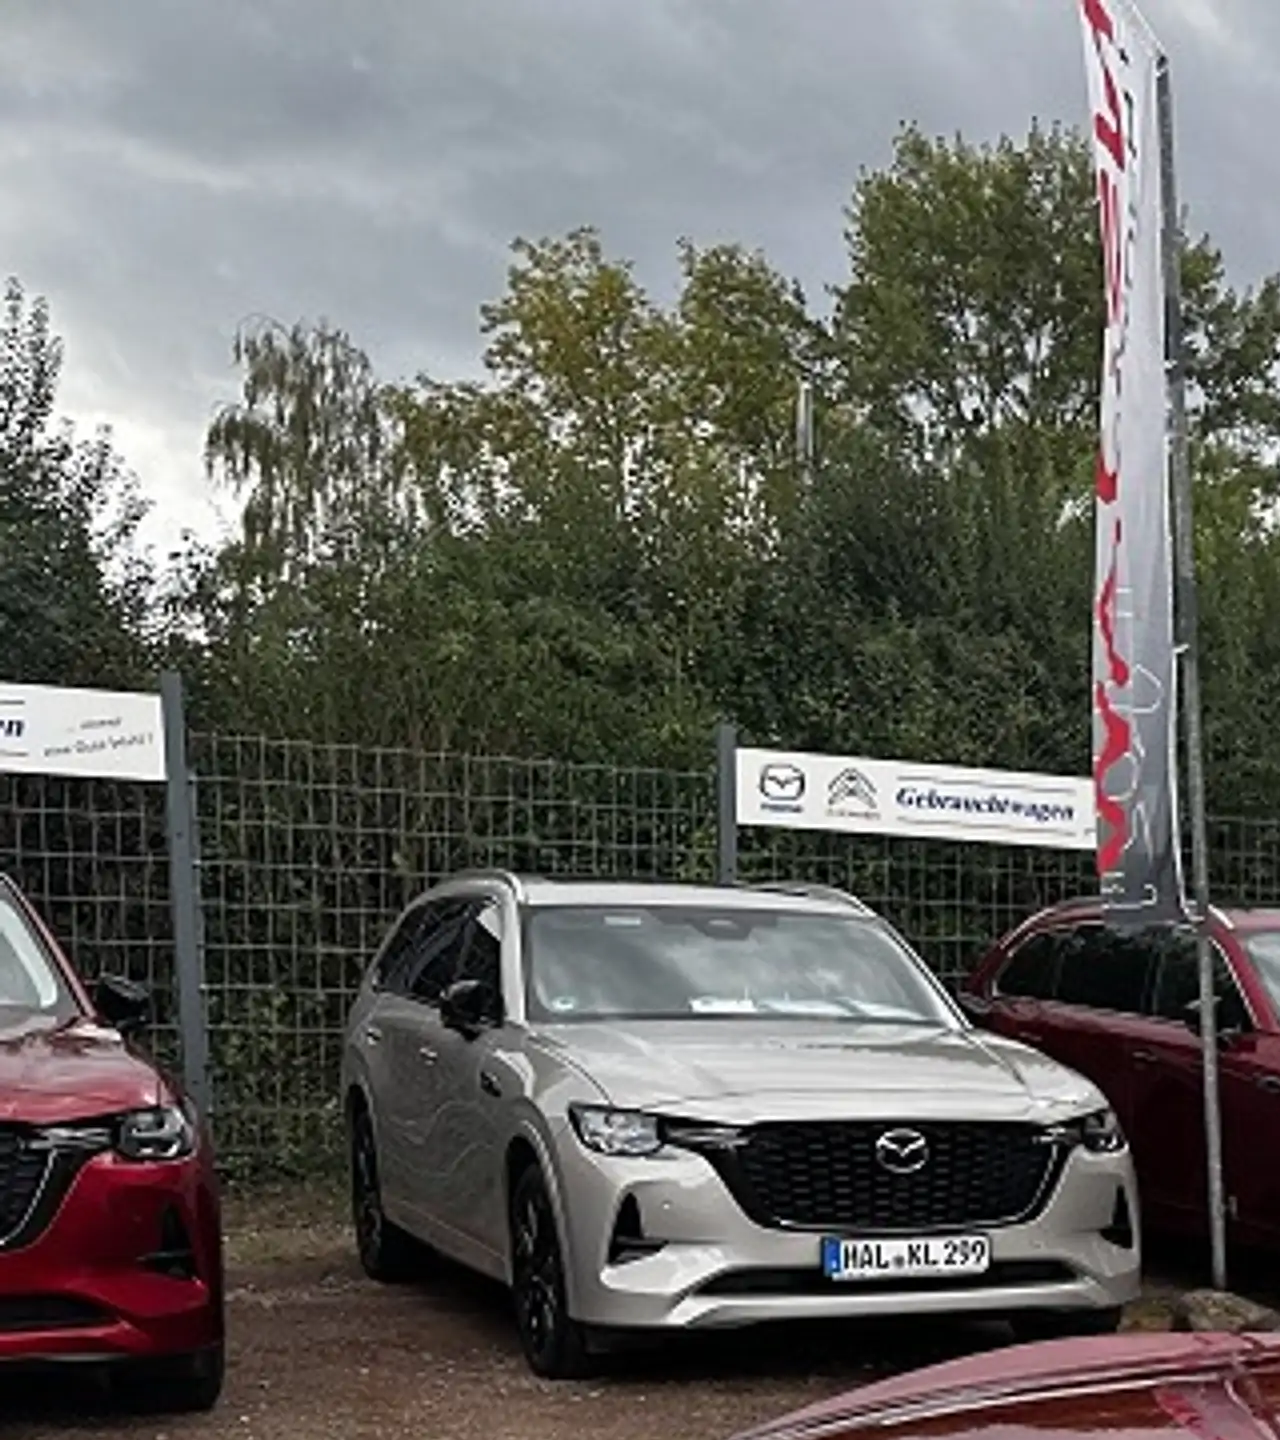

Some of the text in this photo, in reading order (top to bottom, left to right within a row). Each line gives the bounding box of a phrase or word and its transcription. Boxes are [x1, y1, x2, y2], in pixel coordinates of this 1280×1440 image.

[896, 786, 1074, 822] Gebrauchtwagen
[844, 1243, 889, 1270] HAL
[907, 1242, 938, 1266] KL
